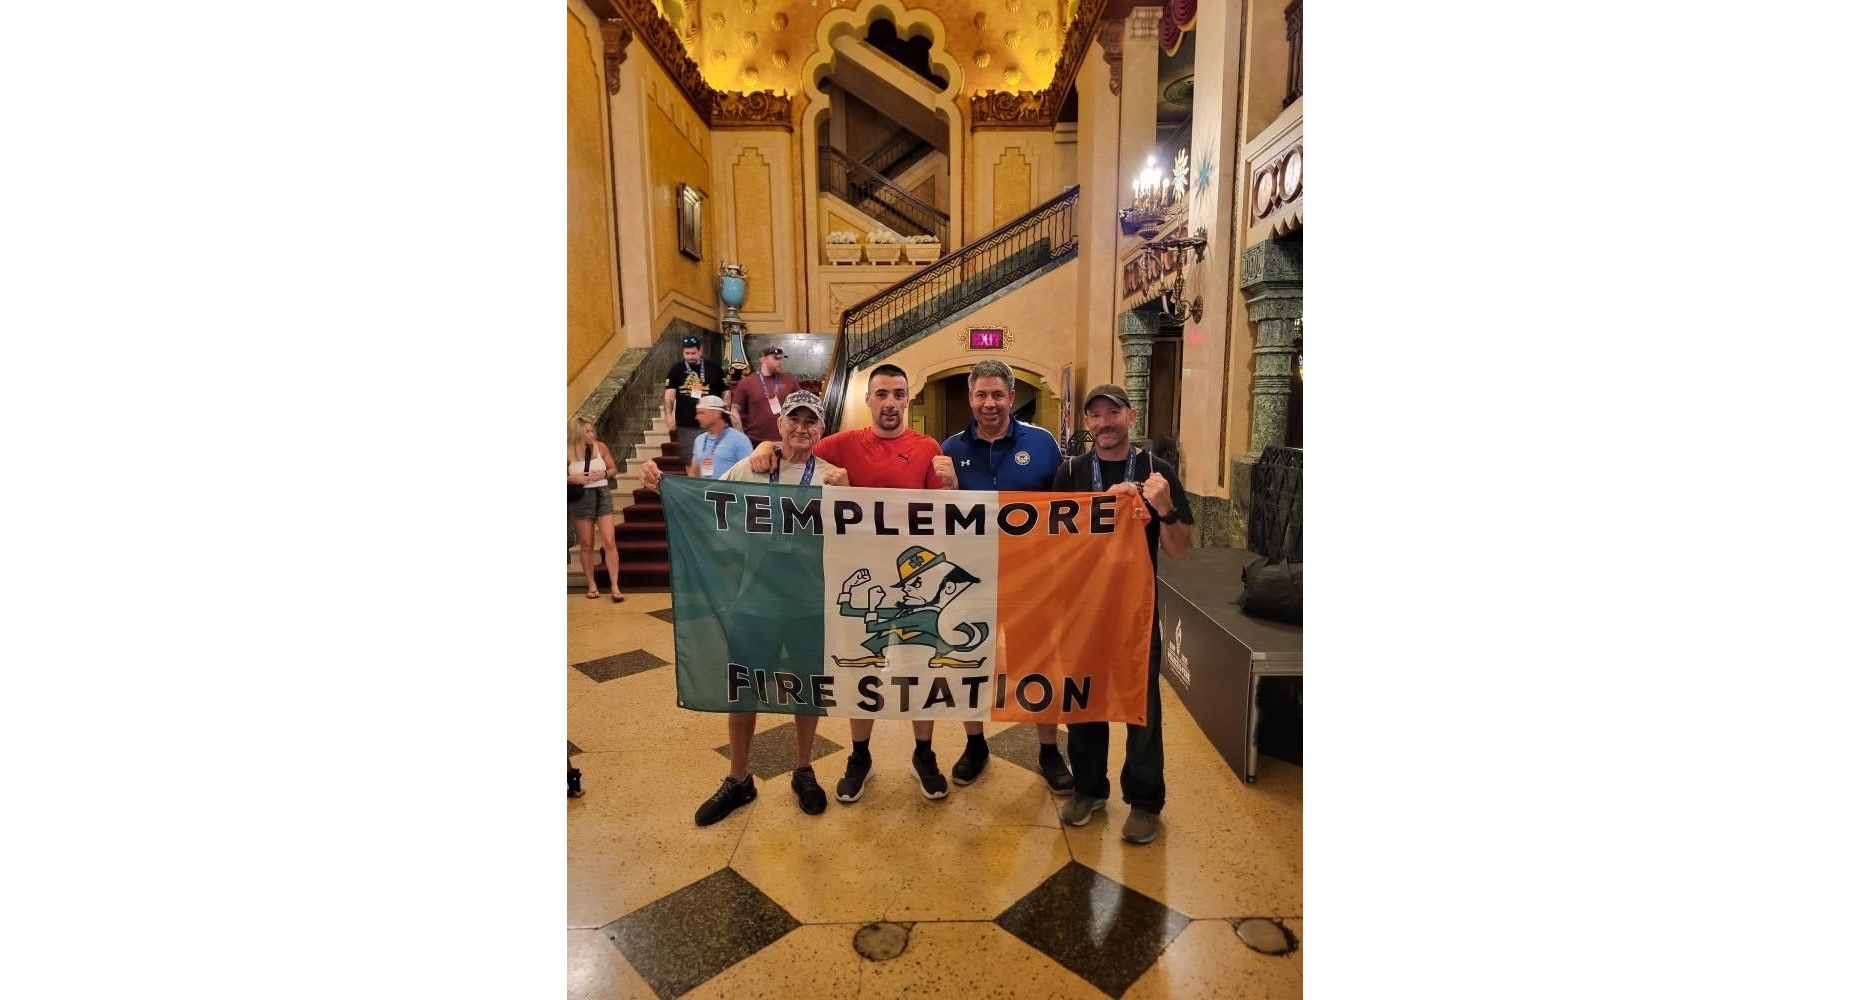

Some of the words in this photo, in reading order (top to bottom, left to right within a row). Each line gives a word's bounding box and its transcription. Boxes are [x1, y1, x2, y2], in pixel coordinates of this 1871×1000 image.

[972, 333, 1000, 346] EXIT
[704, 491, 1118, 536] TEMPLEMORE
[727, 664, 837, 708] FIRE
[857, 673, 1092, 713] STATION
